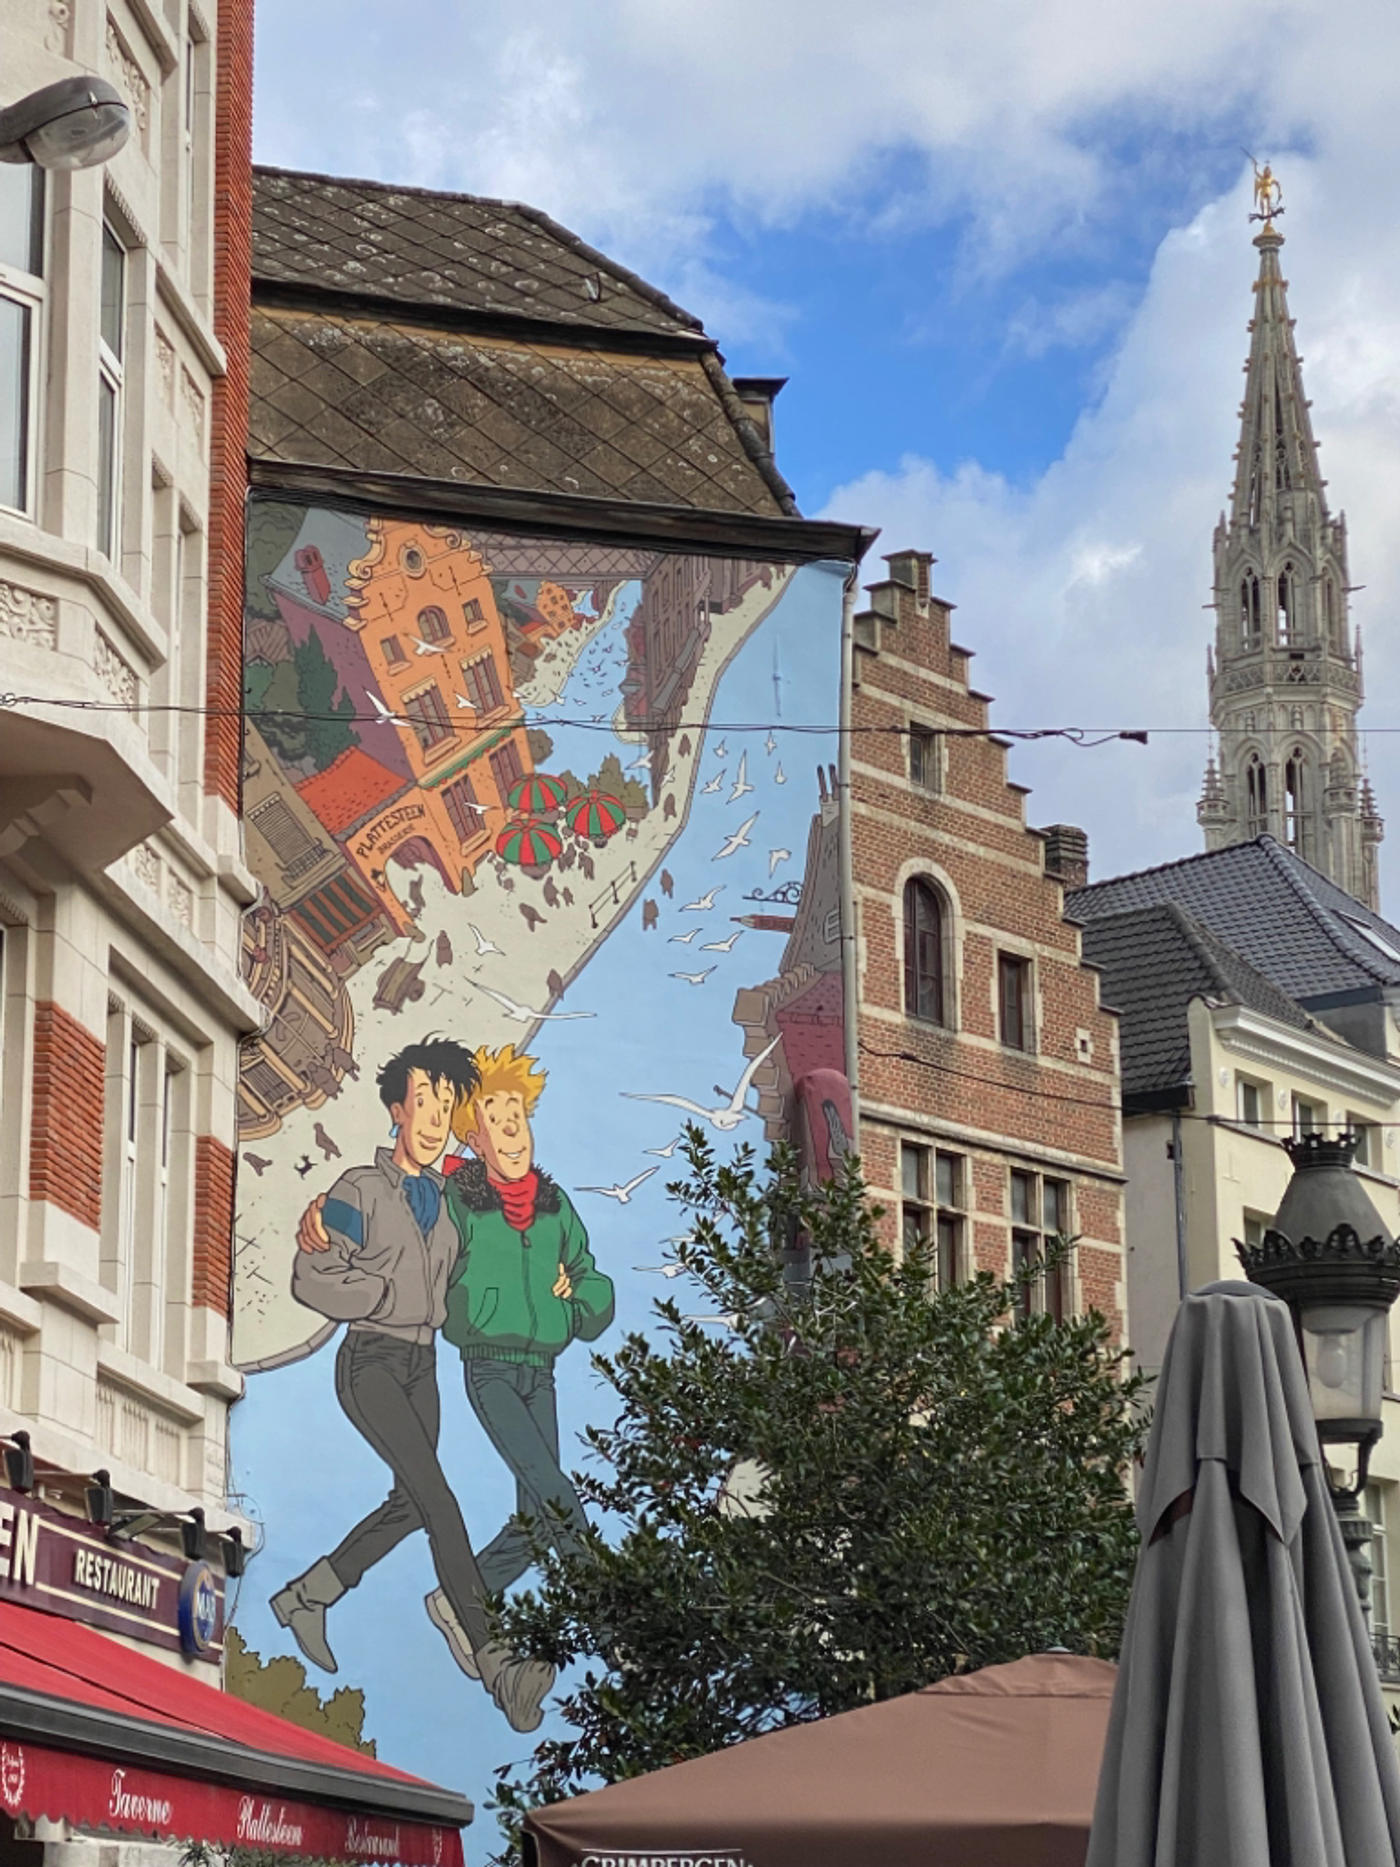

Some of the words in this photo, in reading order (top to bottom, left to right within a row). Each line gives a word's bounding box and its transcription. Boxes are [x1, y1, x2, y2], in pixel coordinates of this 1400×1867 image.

[75, 1548, 160, 1609] RESTAURANT
[109, 1768, 171, 1825] Taverne
[237, 1795, 302, 1846] Plattesteen
